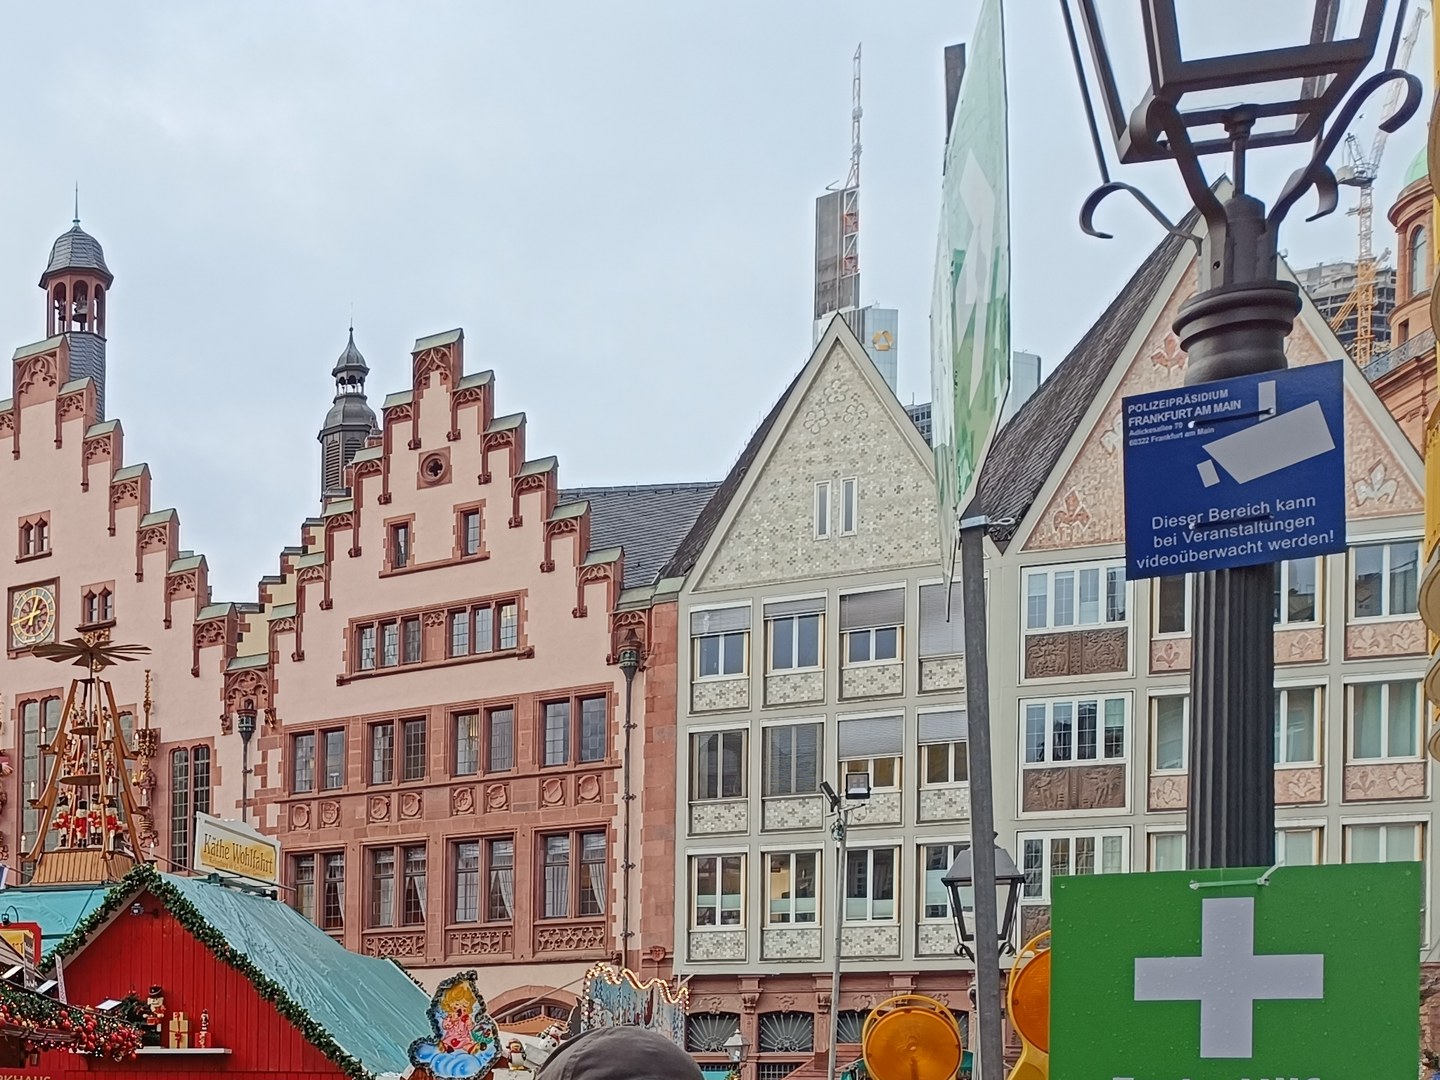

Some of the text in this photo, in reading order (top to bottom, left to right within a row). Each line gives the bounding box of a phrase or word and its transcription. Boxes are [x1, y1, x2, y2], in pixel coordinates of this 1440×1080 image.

[1127, 388, 1229, 414] POLIZEIPRÄSIDIUM
[1128, 400, 1242, 427] FRANKFURT AM MAIN
[1128, 421, 1183, 437] Adickesallee 70
[1150, 432, 1184, 443] Frankfurt
[1184, 430, 1196, 438] am
[1197, 427, 1215, 436] Main
[1151, 496, 1317, 530] Dieser Bereich kann
[1153, 515, 1316, 549] bei Veranstaltungen
[1136, 529, 1335, 569] videoüberwacht werden!
[203, 833, 230, 860] Käthe
[232, 842, 273, 874] Wohlfahrt
